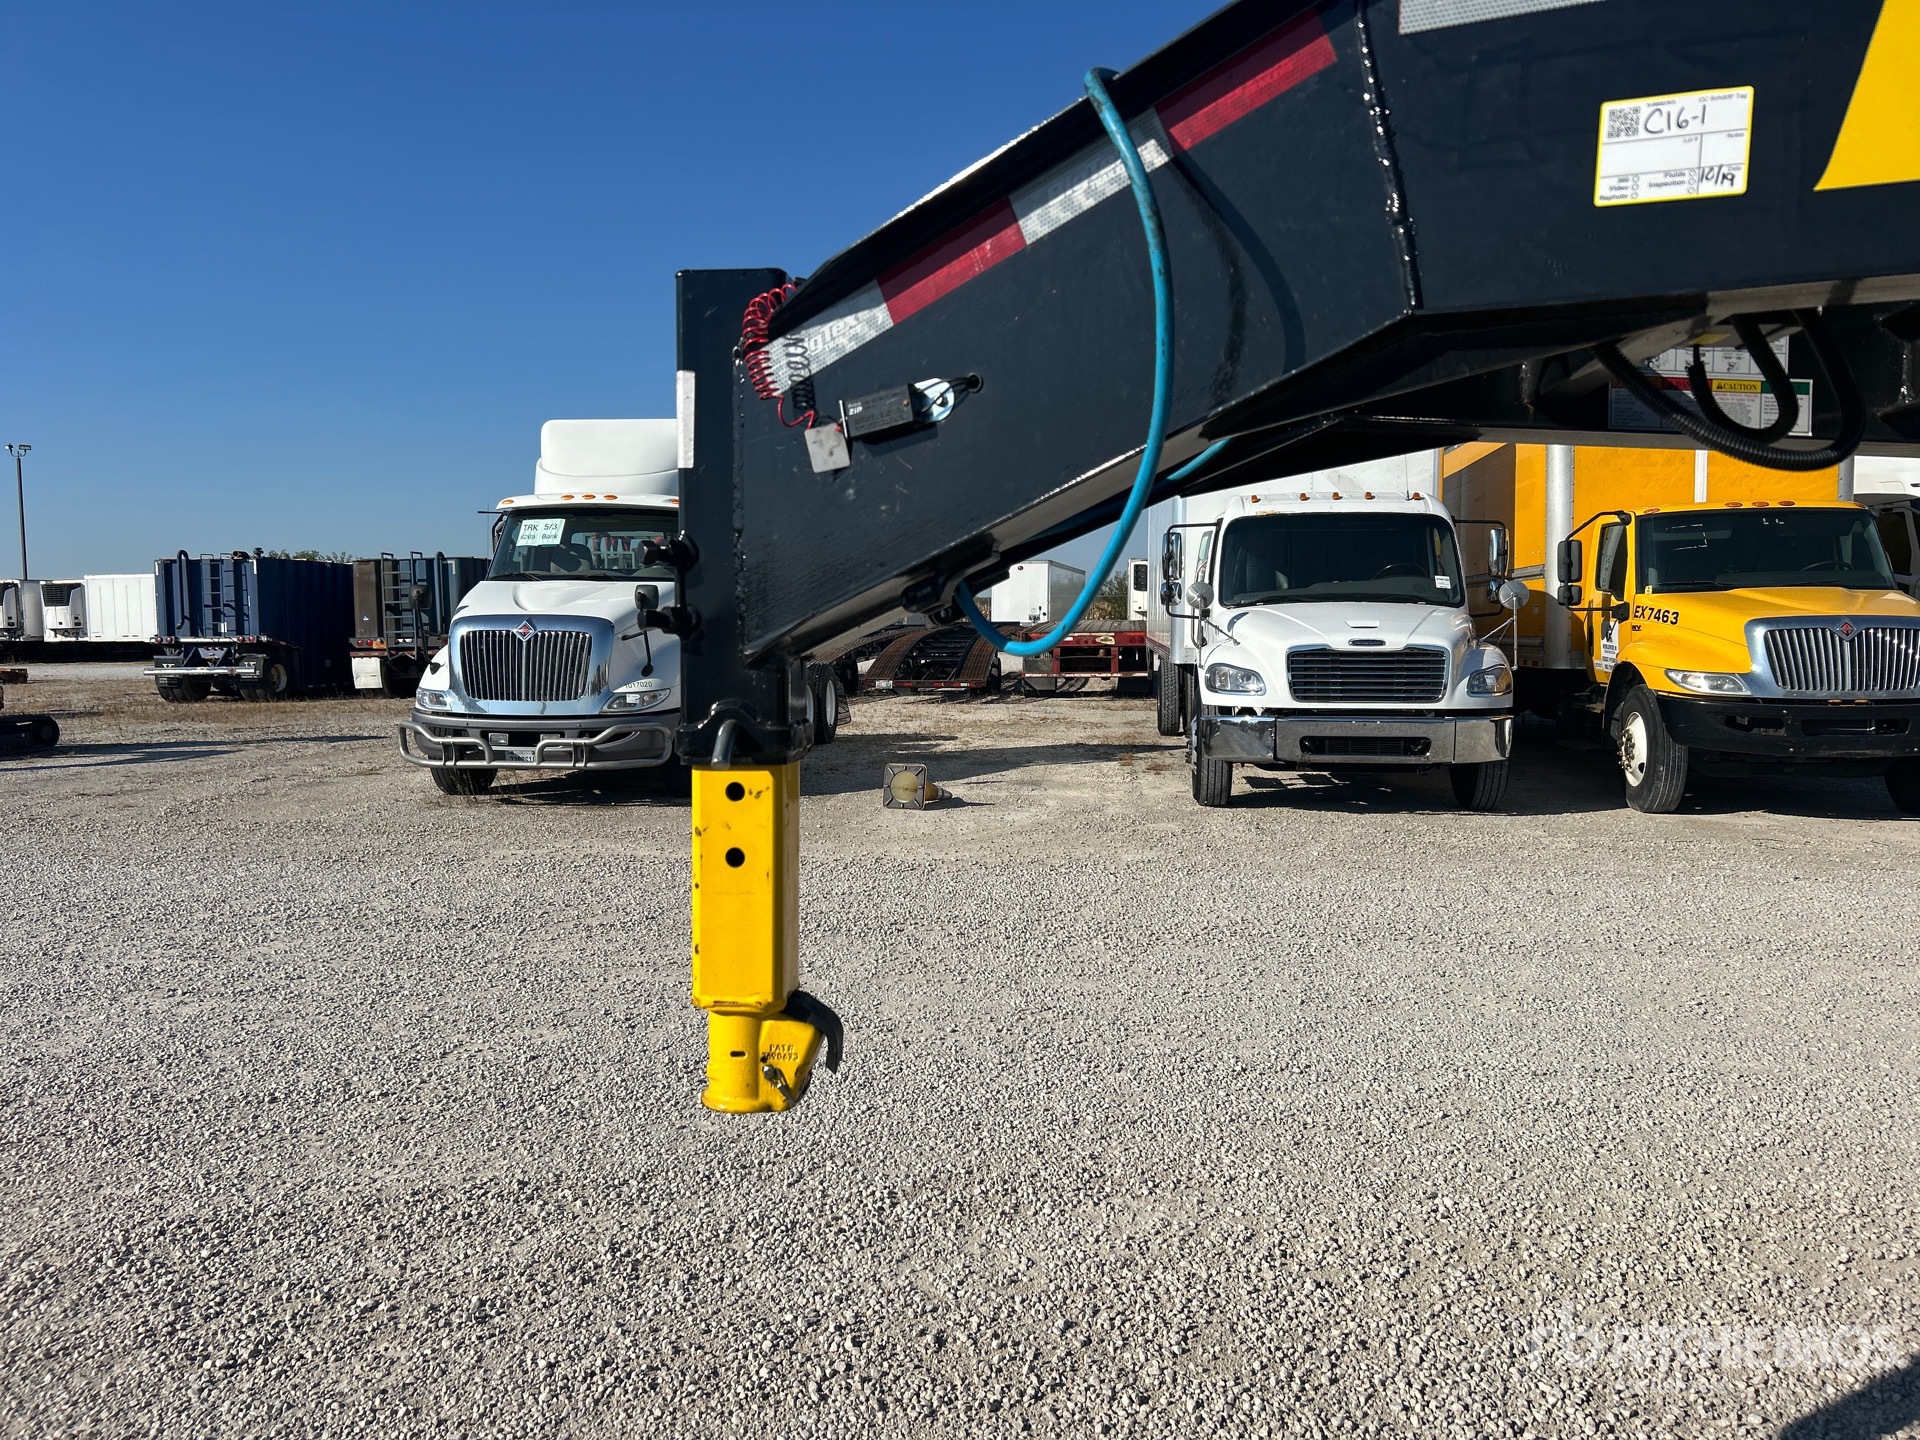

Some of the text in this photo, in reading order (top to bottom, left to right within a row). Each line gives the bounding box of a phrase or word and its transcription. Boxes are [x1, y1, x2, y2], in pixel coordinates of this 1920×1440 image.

[1644, 104, 1707, 134] C16-1
[1723, 383, 1758, 391] CAUTION
[543, 523, 558, 531] 5/3
[1633, 605, 1680, 625] EX7463
